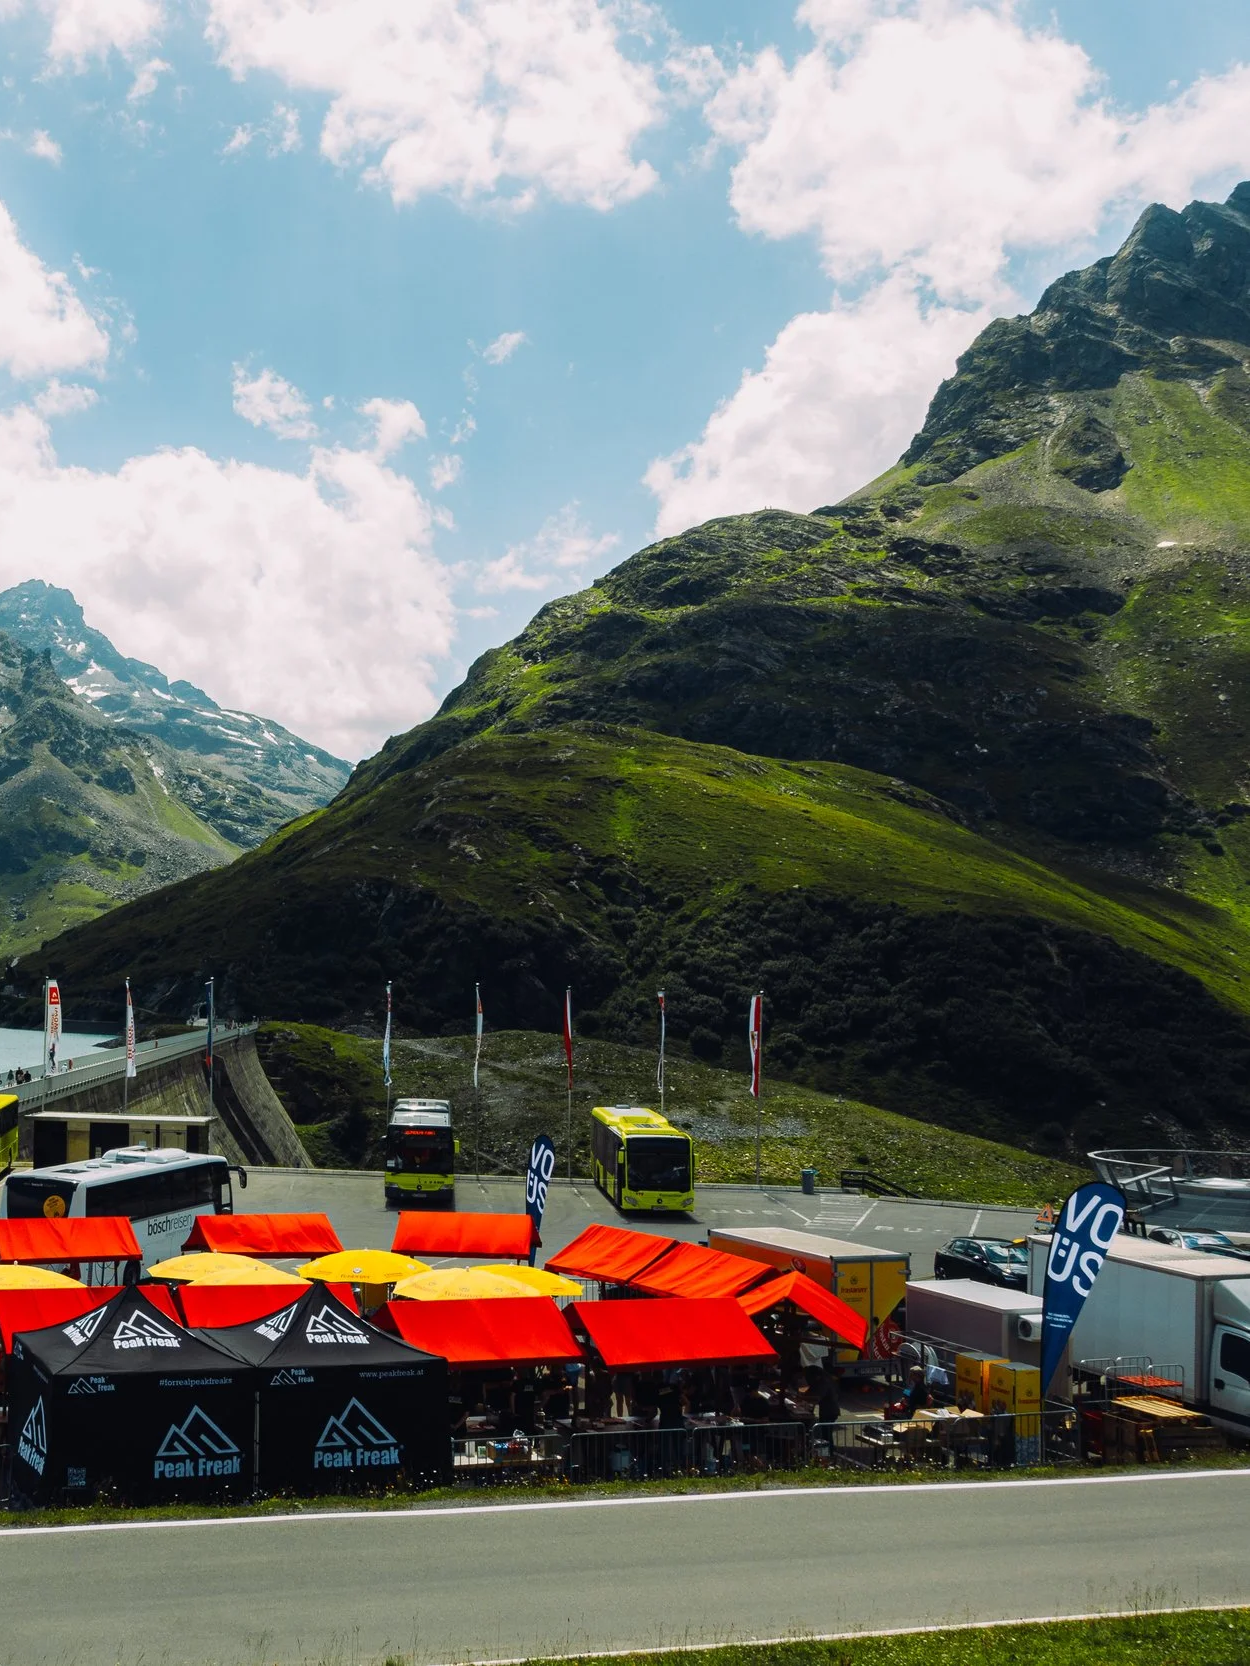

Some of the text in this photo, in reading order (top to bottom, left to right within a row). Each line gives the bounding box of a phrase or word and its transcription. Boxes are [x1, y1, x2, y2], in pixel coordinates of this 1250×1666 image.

[531, 1142, 555, 1182] VO
[1066, 1191, 1124, 1250] VO
[113, 1336, 180, 1349] Peak Freak
[306, 1333, 370, 1344] Peak Freak
[291, 1368, 306, 1376] Peak
[359, 1369, 424, 1379] www.peakfreak.at
[90, 1376, 106, 1384] Peak
[159, 1377, 233, 1387] #forrealpeakfreaks
[98, 1384, 115, 1392] Freak
[18, 1436, 45, 1476] Peak Freak
[314, 1446, 400, 1469] Peak Freak
[154, 1456, 240, 1479] Peak Freak
